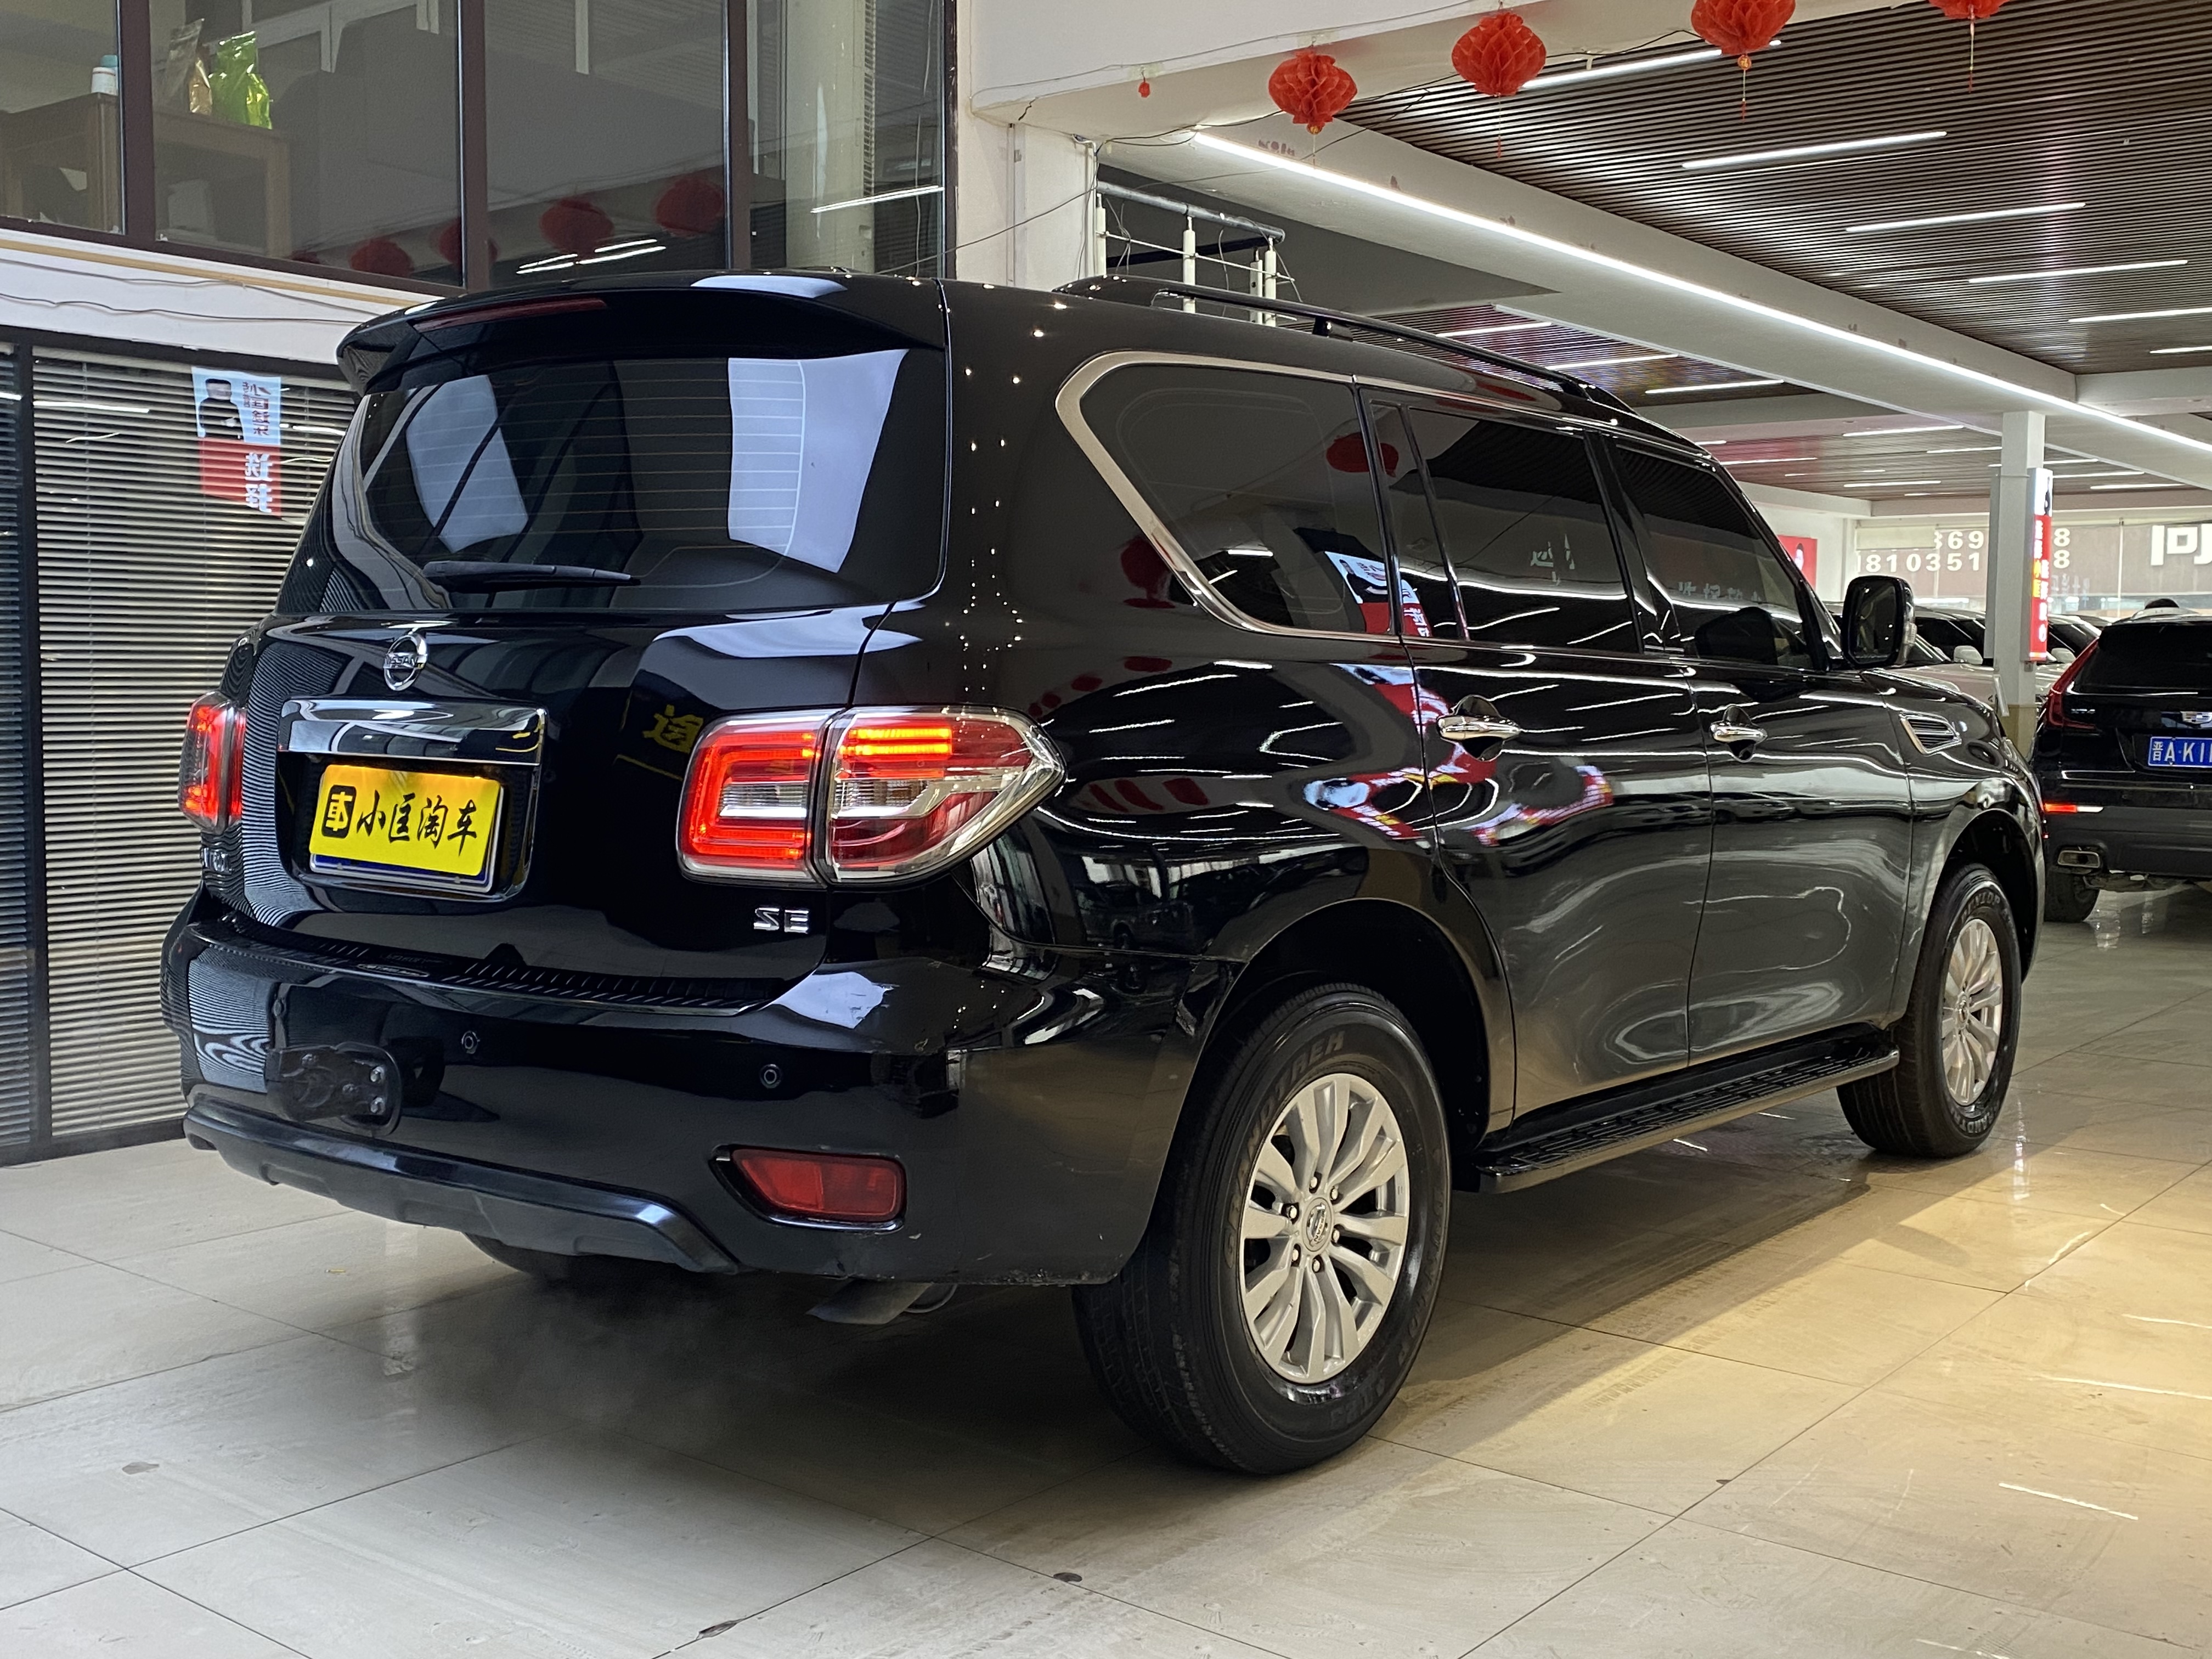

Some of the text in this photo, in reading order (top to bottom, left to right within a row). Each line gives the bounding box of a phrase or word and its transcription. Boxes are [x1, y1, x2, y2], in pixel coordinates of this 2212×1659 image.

[357, 789, 477, 856] 小匡淘车
[753, 906, 809, 934] SE
